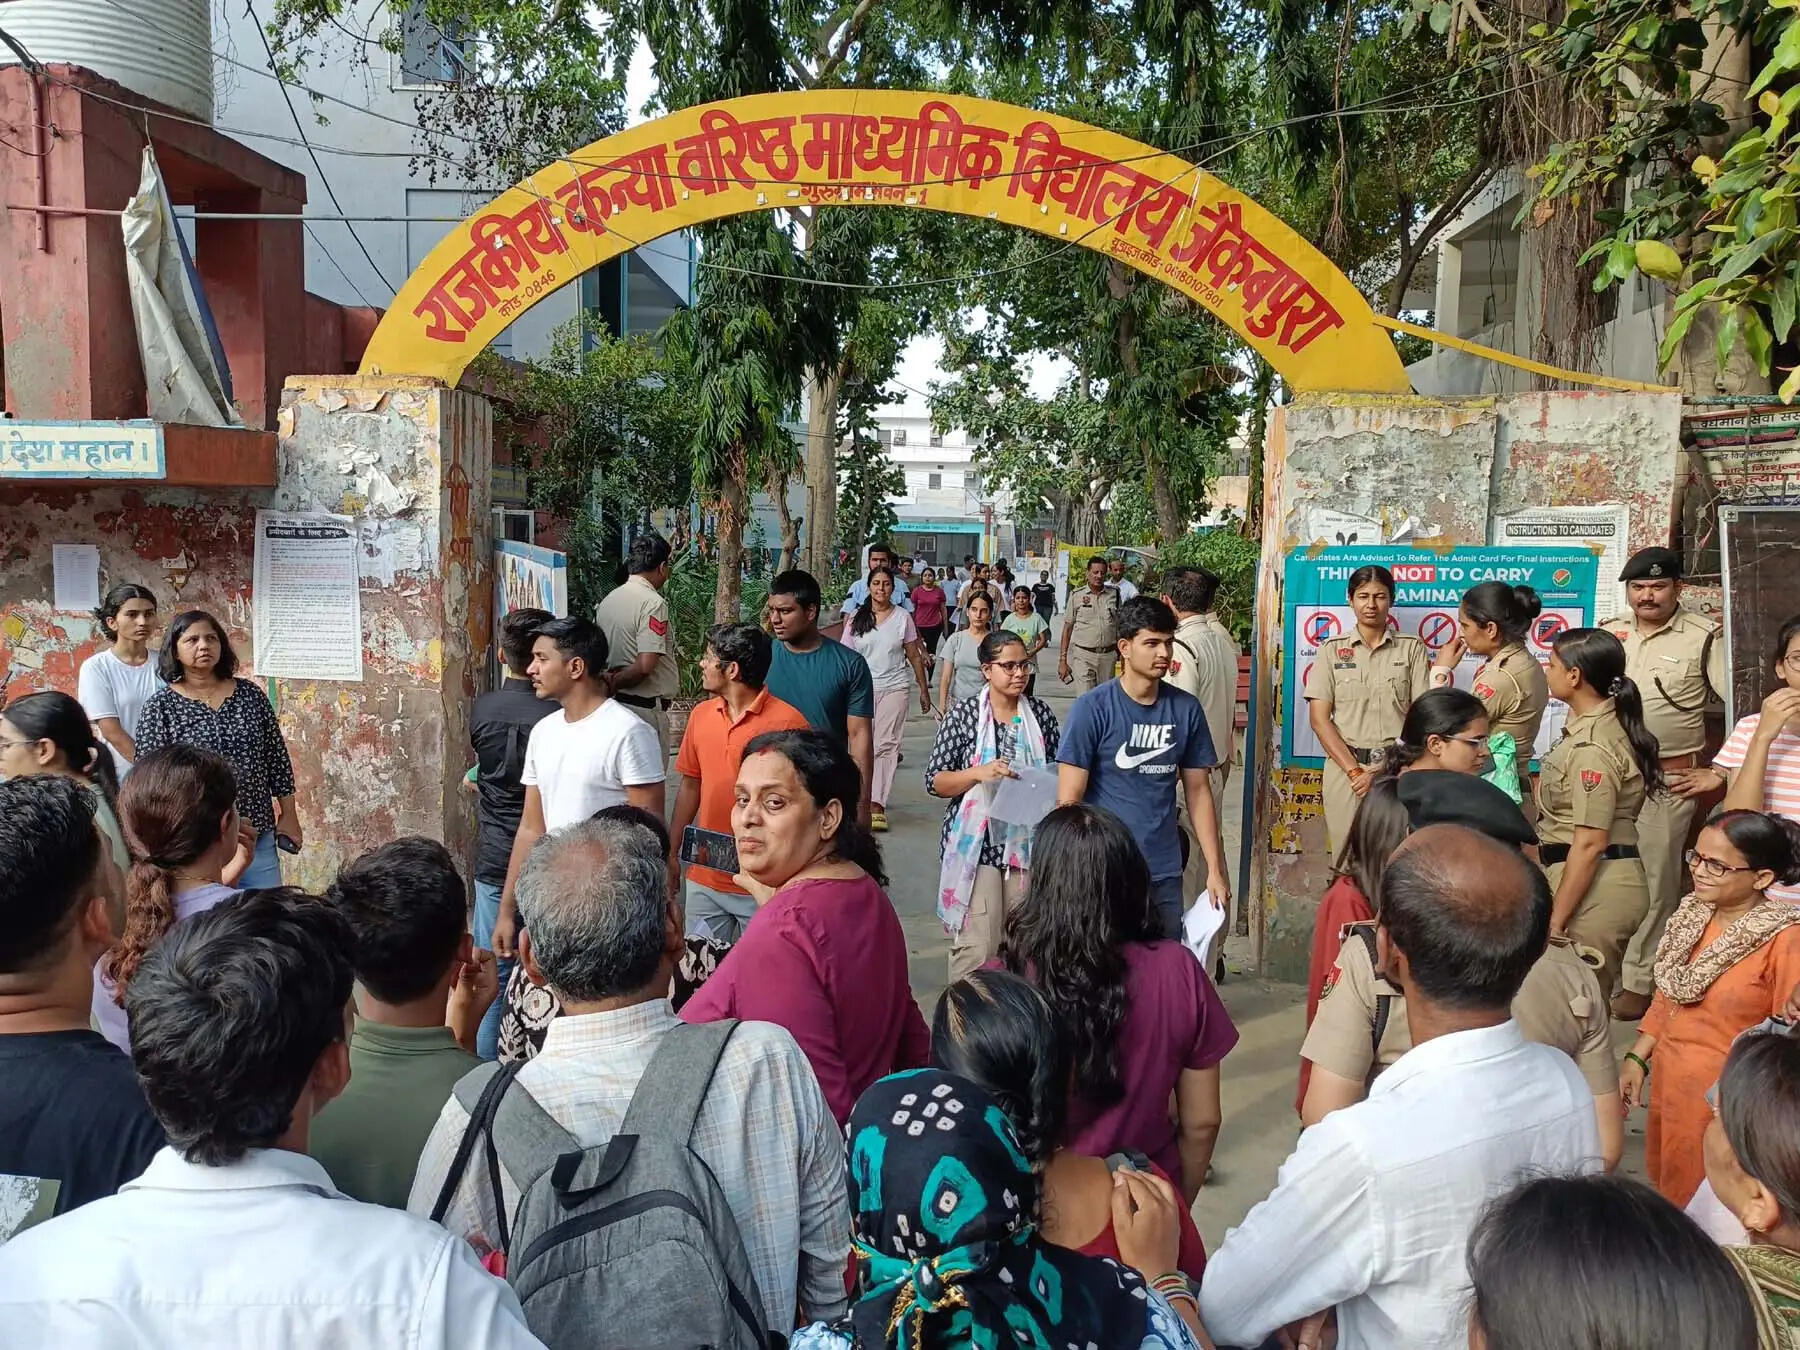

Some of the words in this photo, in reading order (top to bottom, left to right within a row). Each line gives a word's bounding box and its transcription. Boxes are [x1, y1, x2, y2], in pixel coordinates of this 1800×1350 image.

[413, 196, 568, 343] राजकीय
[555, 143, 678, 237] कन्या
[674, 109, 800, 197] वरिष्ठ
[800, 101, 1009, 190] माध्यमिक
[1007, 121, 1192, 250] विद्यालय
[9, 430, 56, 470] देश
[59, 440, 135, 472] महान
[1507, 525, 1557, 536] INSTRUCTIONS
[1559, 525, 1568, 535] TO
[1570, 525, 1614, 536] CANDIDATES
[1343, 554, 1358, 562] Are
[1359, 553, 1394, 562] Advised
[1396, 554, 1406, 562] To
[1408, 554, 1431, 562] Refer
[1434, 554, 1450, 562] The
[1451, 554, 1477, 562] Admit
[1479, 554, 1499, 562] Card
[1540, 555, 1590, 563] Instructions
[1393, 567, 1434, 581] NOT
[1438, 567, 1464, 581] TO
[1469, 567, 1535, 581] CARRY
[1129, 723, 1172, 748] NIKE
